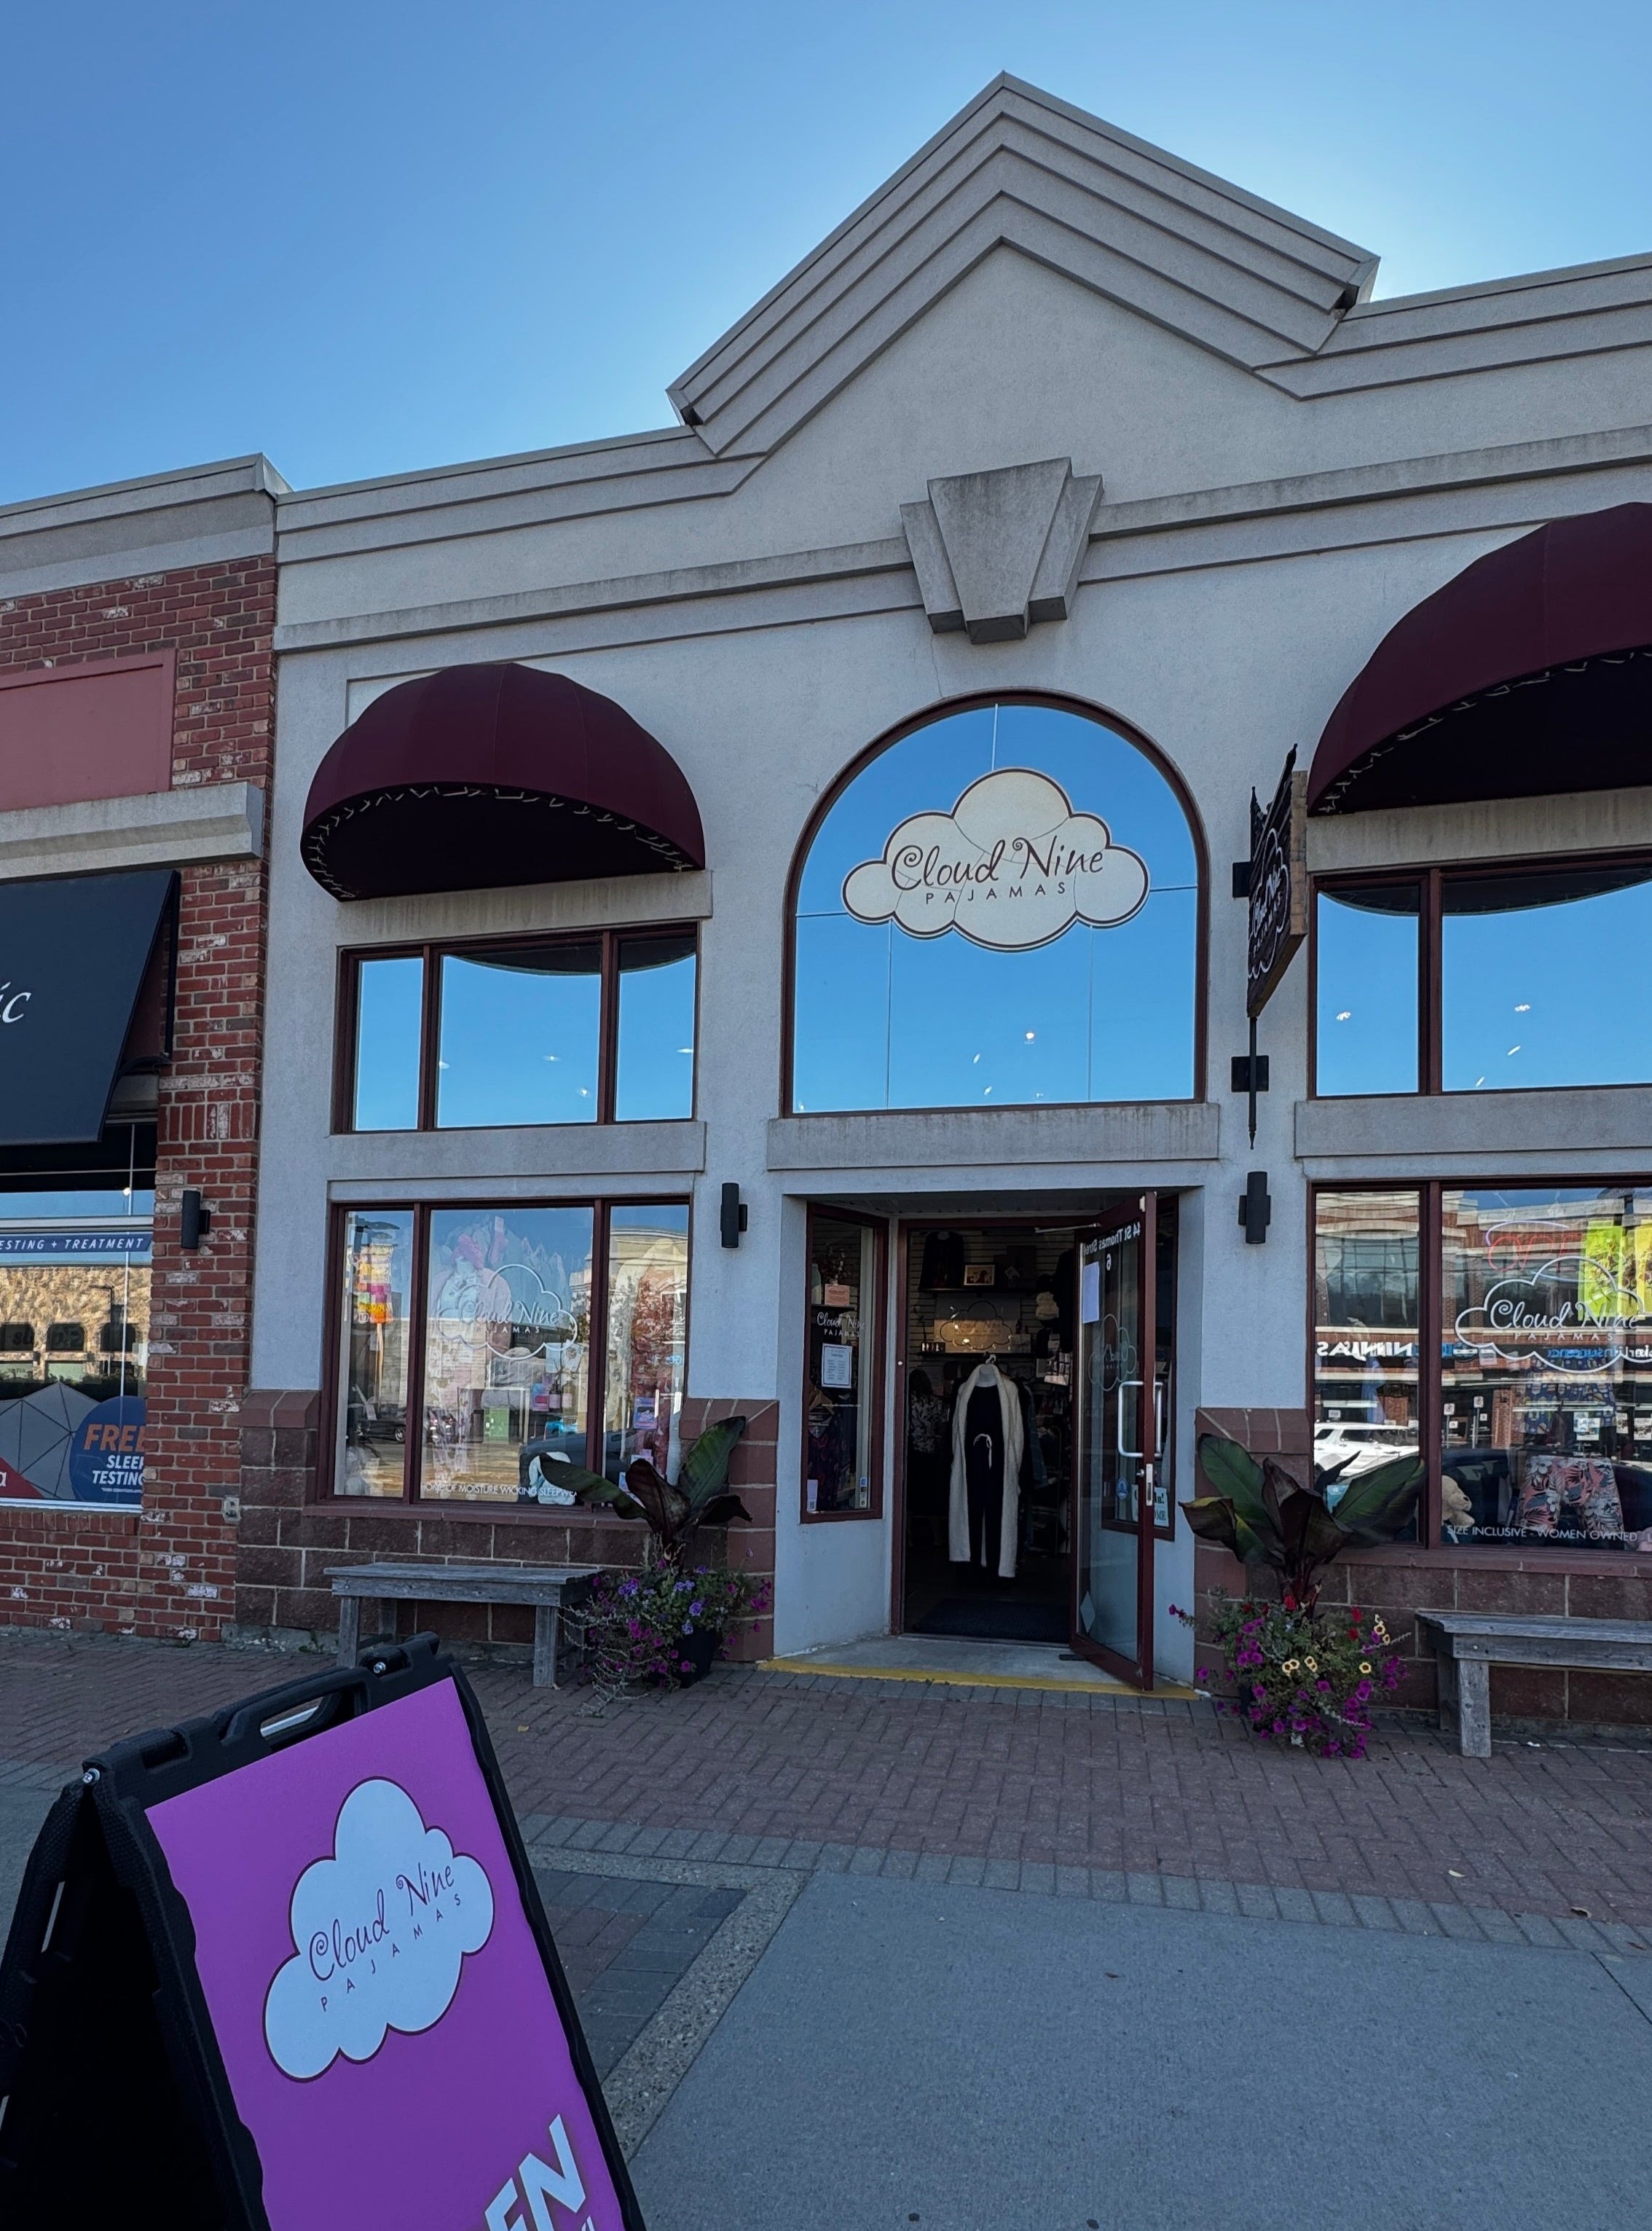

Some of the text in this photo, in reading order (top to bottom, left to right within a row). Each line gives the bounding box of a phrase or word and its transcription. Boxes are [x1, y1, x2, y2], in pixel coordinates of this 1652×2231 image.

[892, 835, 1104, 891] Cloud Nine
[926, 882, 1066, 904] PAJAMAS
[65, 1239, 143, 1249] TREATMENT
[461, 1300, 559, 1324] Cloud Nine
[817, 1311, 843, 1328] Cloud
[1490, 1299, 1641, 1330] Cloud Nine
[824, 1328, 860, 1337] PAJAMAS
[1515, 1333, 1615, 1341] PAJAMAS
[447, 1483, 458, 1492] OF
[459, 1484, 498, 1494] MOISTURE
[500, 1486, 538, 1495] WICKING
[539, 1487, 578, 1497] SLEEPWEA
[1447, 1525, 1468, 1535] SIZE
[1472, 1526, 1527, 1537] INCLUSIVE
[1537, 1529, 1586, 1540] WOMEN
[1589, 1530, 1638, 1542] OWNED
[309, 1862, 455, 1981] Cloud Nine
[320, 1893, 461, 2012] PAJAMAS
